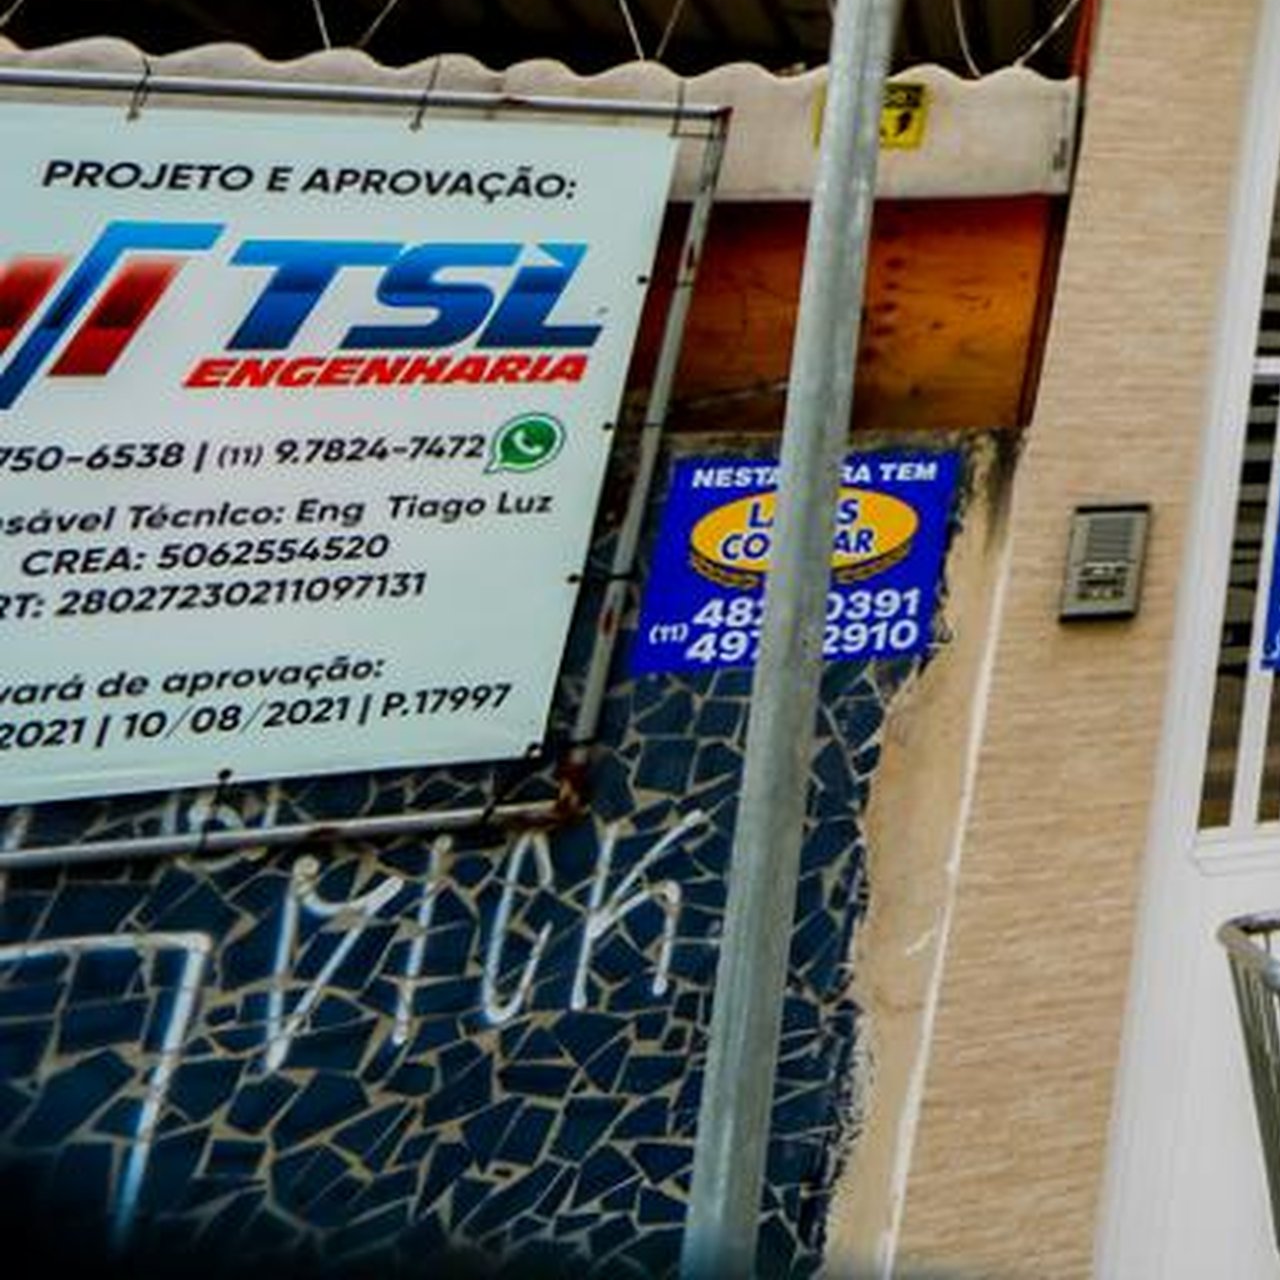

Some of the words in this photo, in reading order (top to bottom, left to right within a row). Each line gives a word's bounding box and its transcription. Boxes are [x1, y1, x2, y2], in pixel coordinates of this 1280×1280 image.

[42, 159, 255, 191] PROJETO
[266, 166, 293, 192] E
[301, 166, 577, 203] APROVAÇÃO:
[225, 238, 604, 350] TSL
[182, 354, 588, 388] ENGENHARIA
[217, 444, 264, 468] (11)
[275, 434, 486, 465] 9.7824-7472
[692, 466, 779, 489] NEST
[879, 462, 939, 481] TEM
[0, 506, 117, 536] sável
[128, 501, 287, 531] Técnico:
[387, 493, 487, 524] Tiago
[496, 491, 555, 515] Luz
[21, 546, 148, 577] CREA:
[156, 534, 390, 570] 5062554520
[54, 571, 427, 617] 28027230211097131
[96, 671, 150, 699] de
[162, 655, 386, 699] aprovação:
[123, 694, 352, 740] 10/08/2021
[380, 682, 512, 718] P.17997
